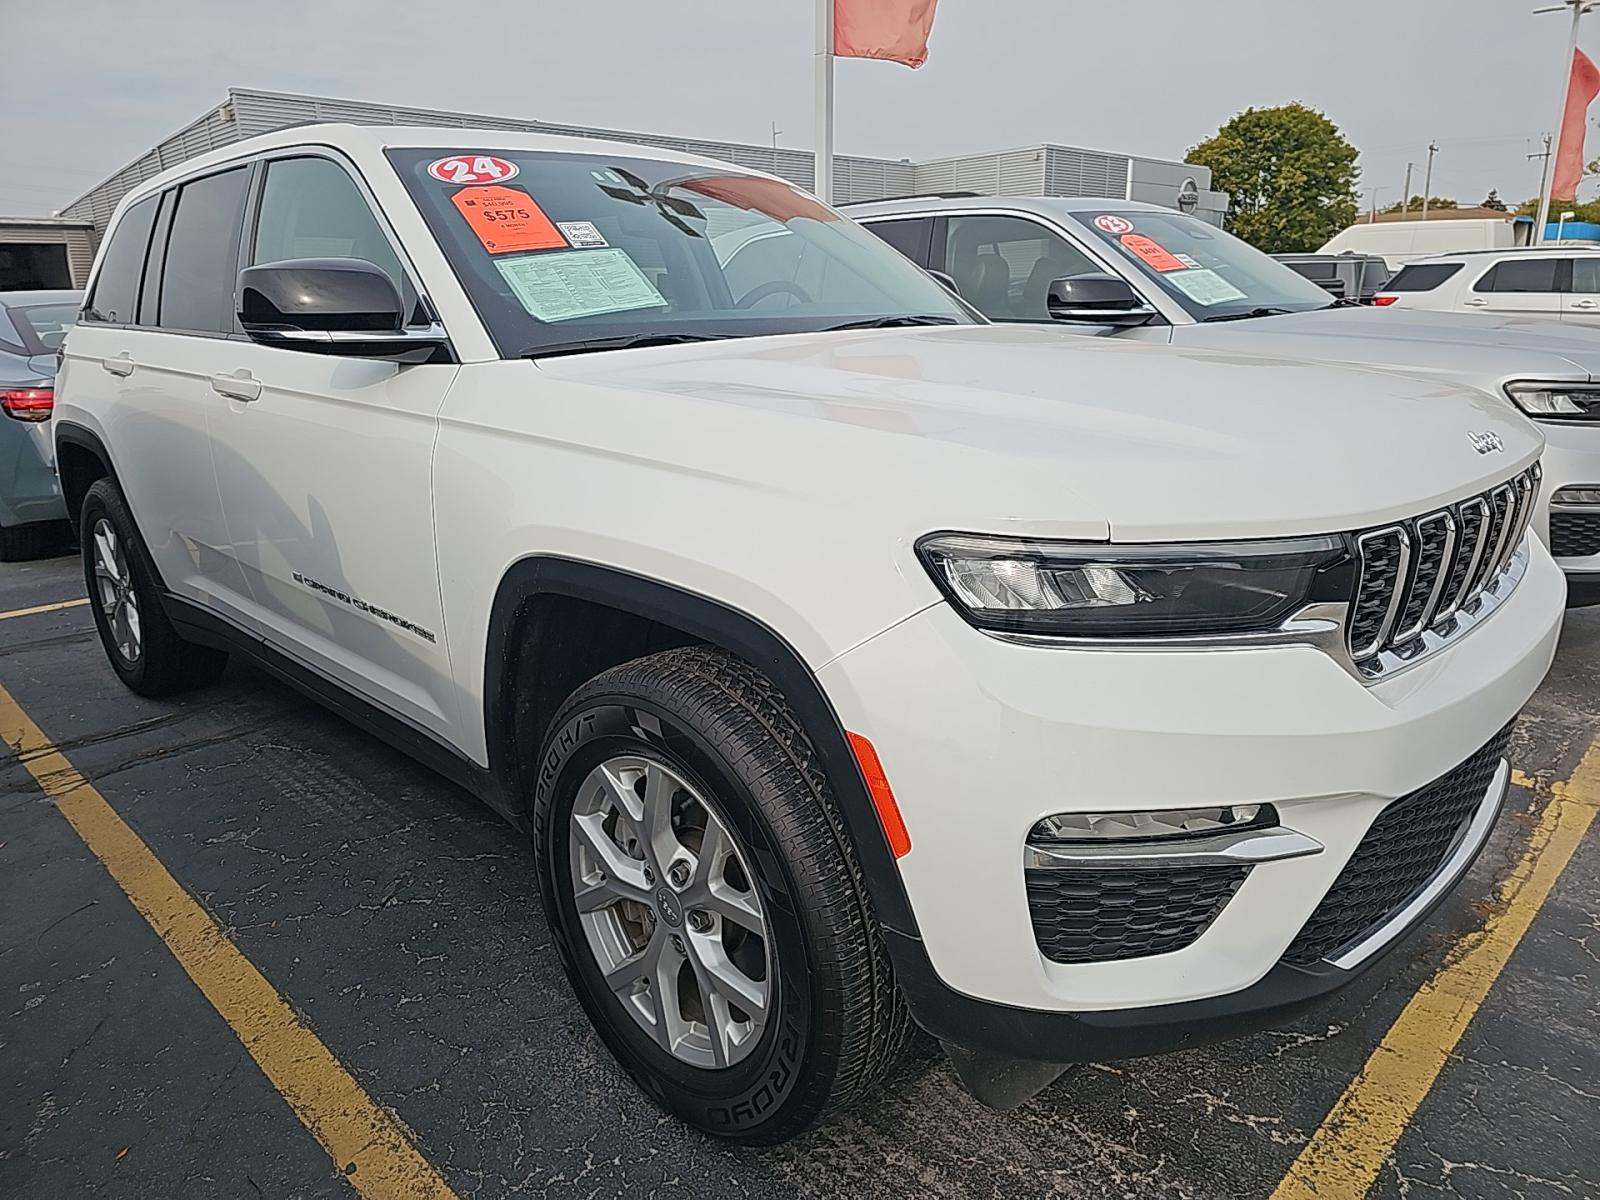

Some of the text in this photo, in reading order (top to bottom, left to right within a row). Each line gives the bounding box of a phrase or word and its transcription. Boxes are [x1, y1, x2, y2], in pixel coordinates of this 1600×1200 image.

[443, 156, 502, 182] 24
[483, 209, 530, 222] $575
[537, 748, 562, 807] PRO
[559, 713, 597, 753] H/T
